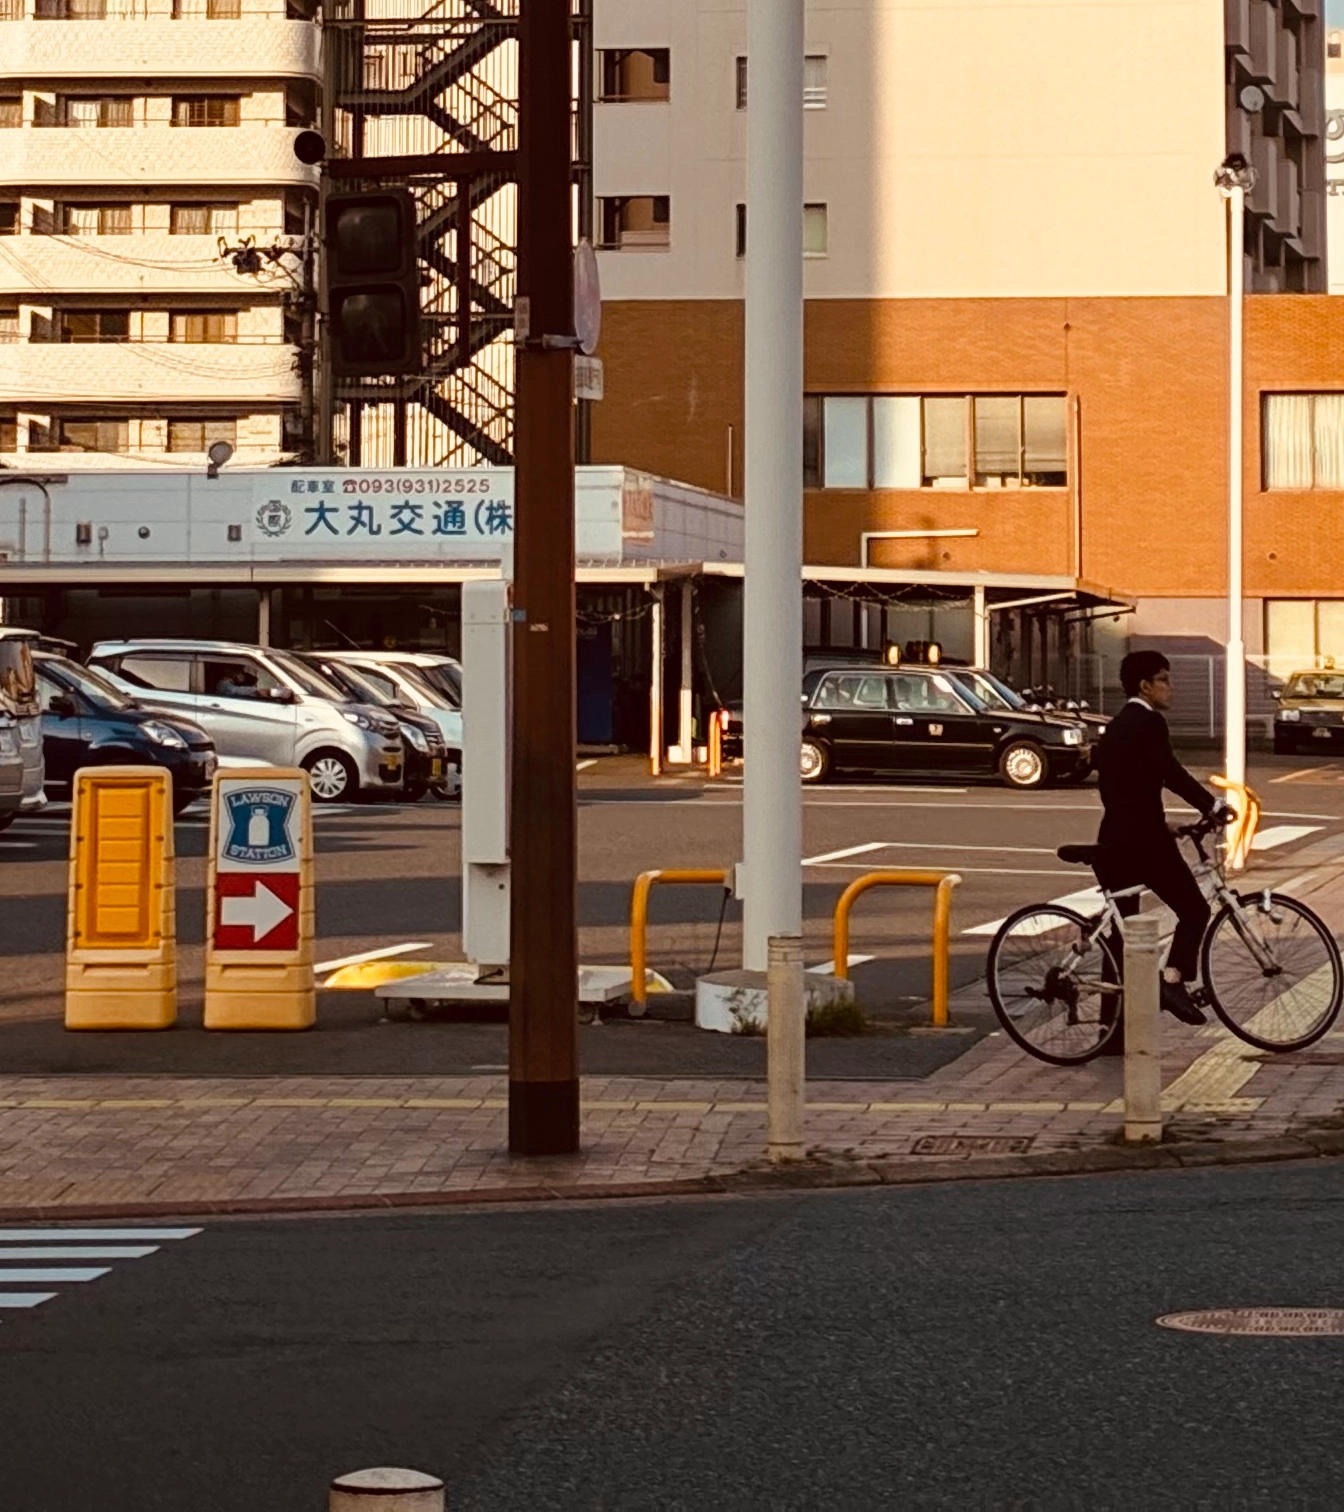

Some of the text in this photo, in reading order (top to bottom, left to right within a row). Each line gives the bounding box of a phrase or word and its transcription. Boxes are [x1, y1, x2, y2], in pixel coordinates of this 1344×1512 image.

[358, 478, 490, 494] 093(931)2525
[230, 792, 289, 807] LAWSON
[229, 844, 288, 859] STATION
